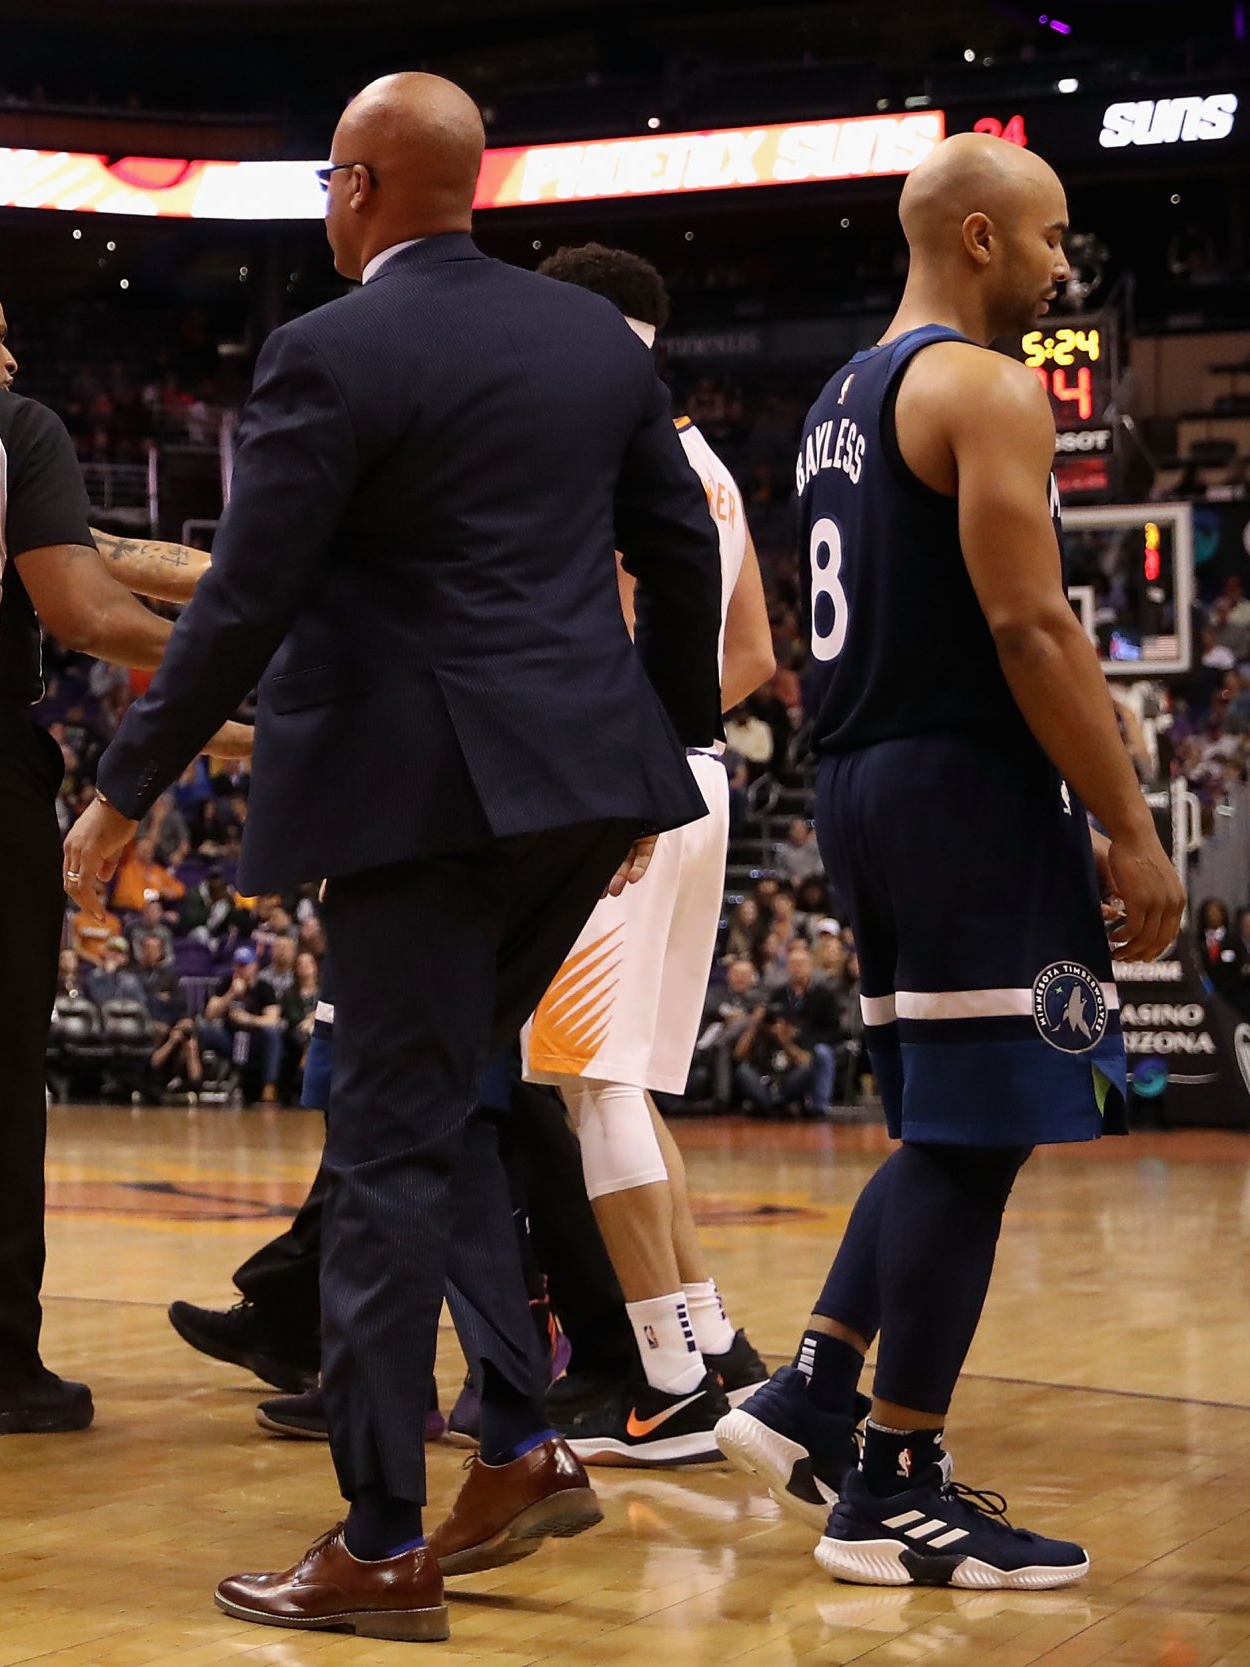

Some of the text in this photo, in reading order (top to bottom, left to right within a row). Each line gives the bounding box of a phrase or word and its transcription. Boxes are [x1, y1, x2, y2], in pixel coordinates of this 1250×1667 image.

[1100, 94, 1238, 148] SUNS
[519, 113, 940, 201] PHOENIX SUNS
[1022, 329, 1099, 368] 5:24
[796, 418, 865, 496] BAYLESS
[810, 518, 848, 661] 8
[1035, 965, 1105, 1032] MINNESOTA TIMBERWOLVES
[1120, 1003, 1204, 1027] ASINO
